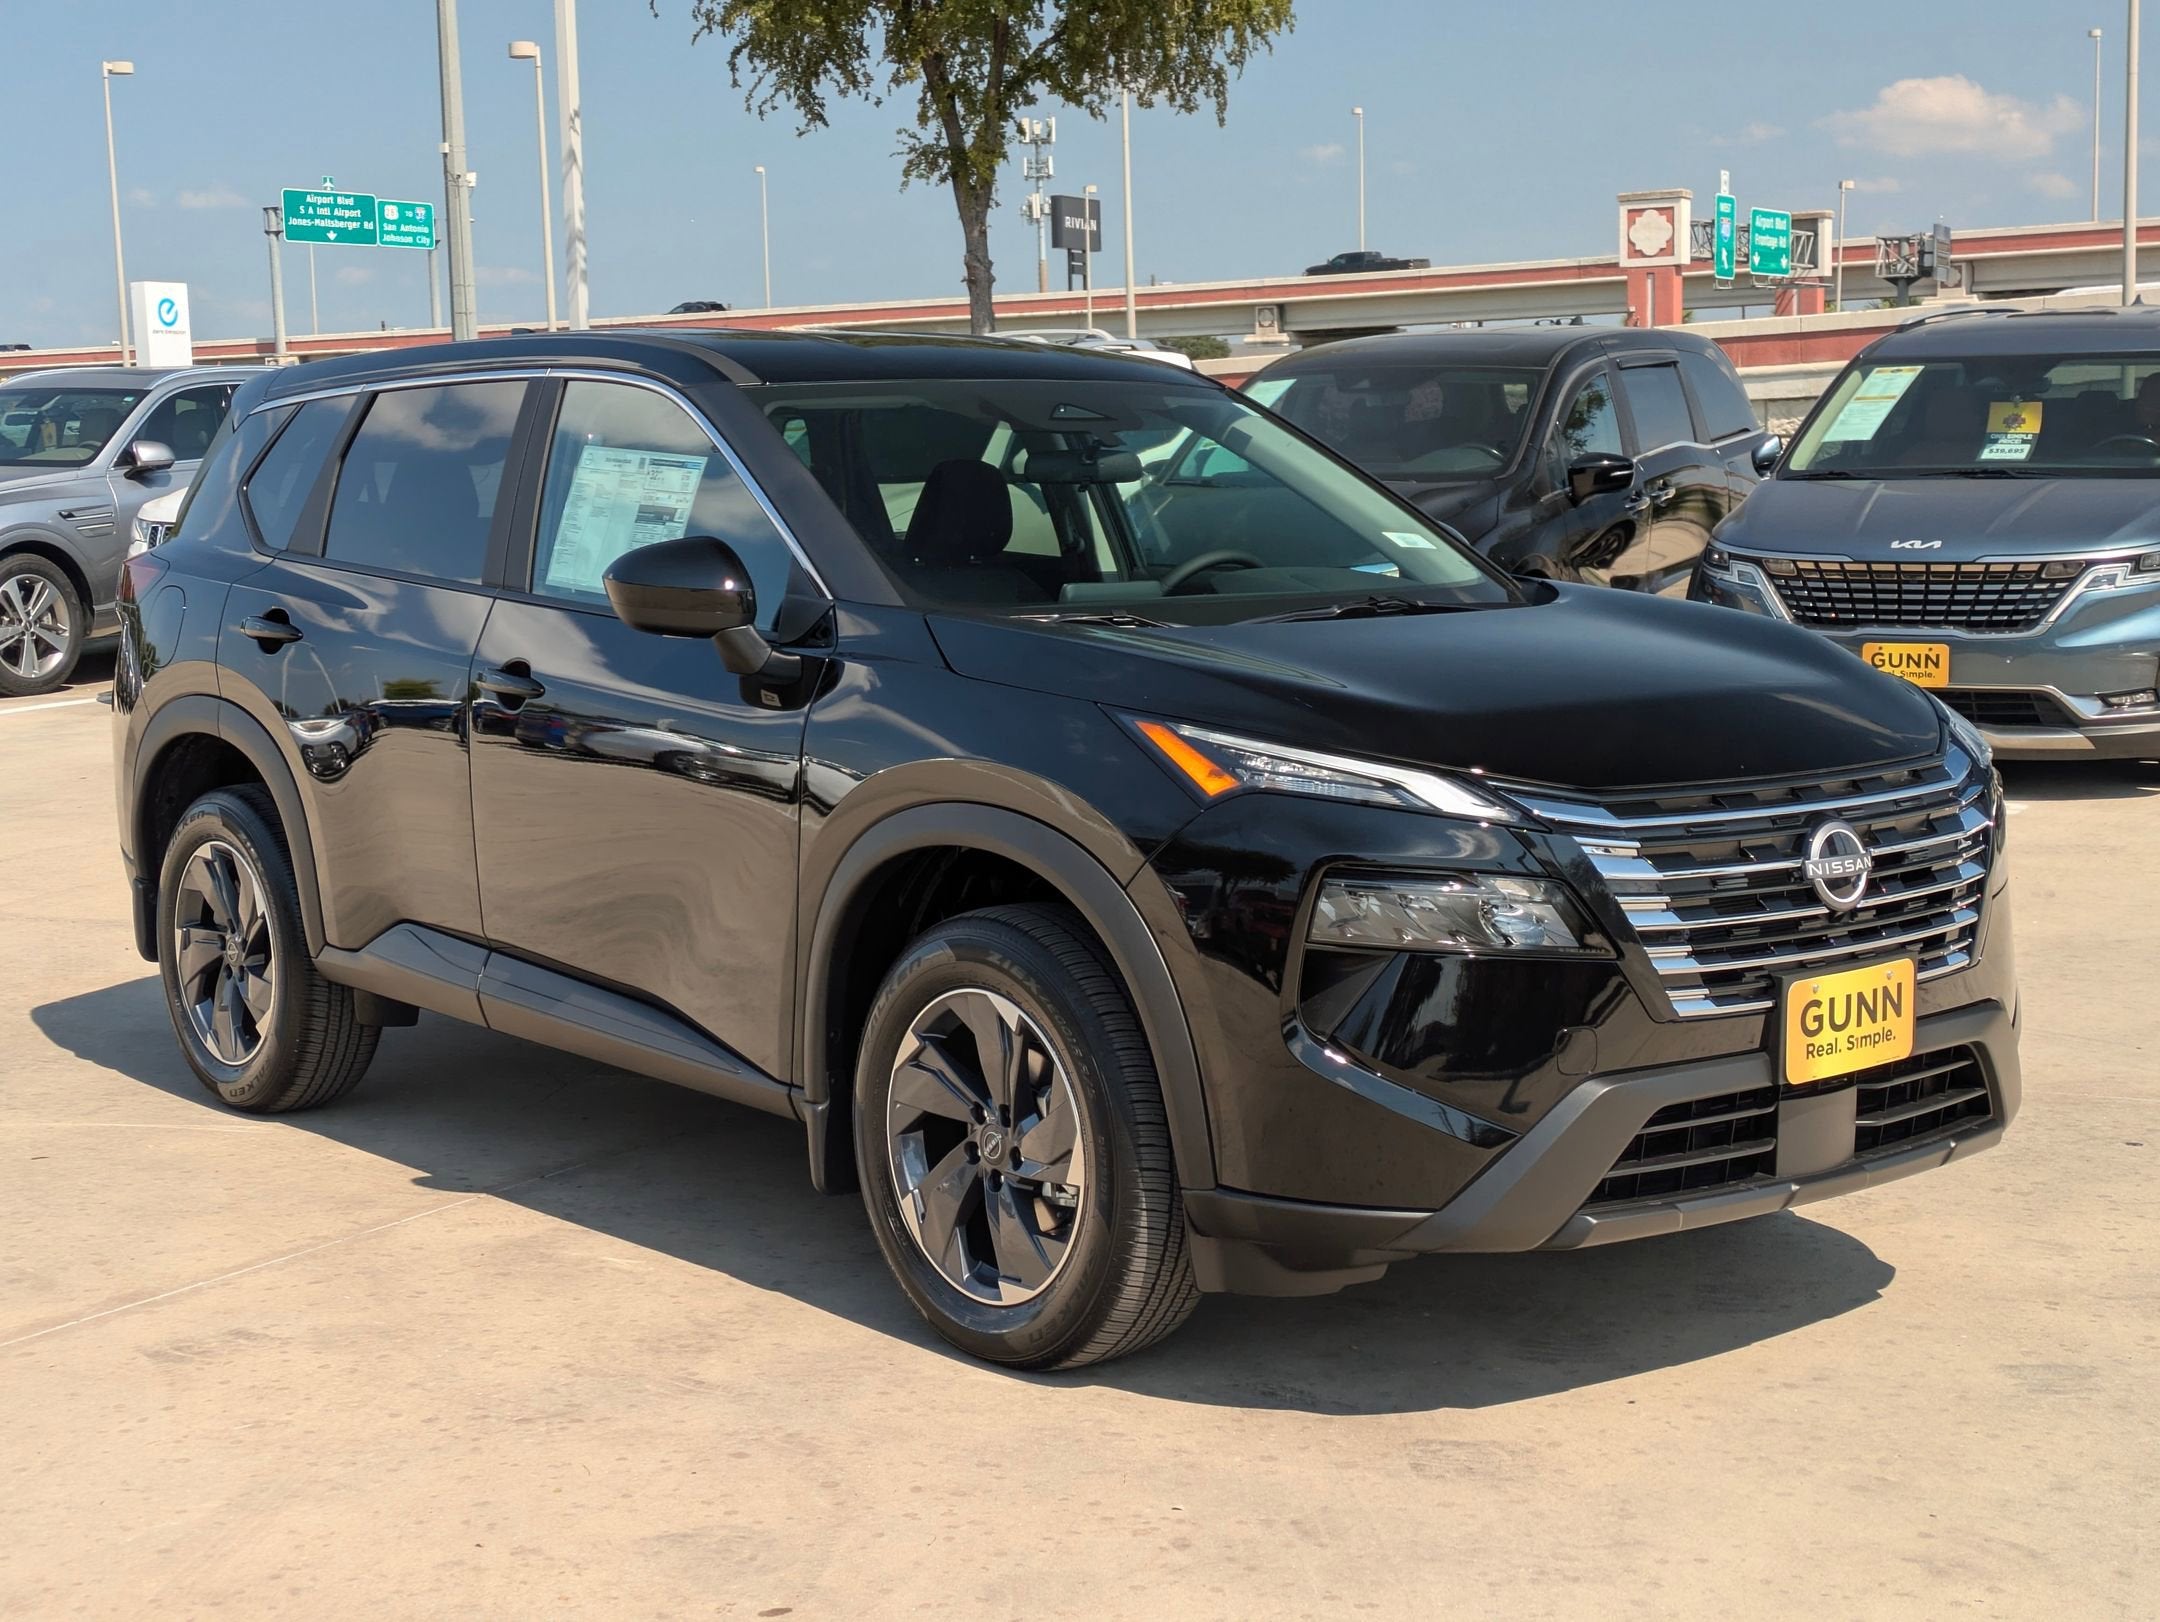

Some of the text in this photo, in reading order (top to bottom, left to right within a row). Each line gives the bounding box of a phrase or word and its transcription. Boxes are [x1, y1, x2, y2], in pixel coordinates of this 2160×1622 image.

[305, 194, 355, 206] Airport Blvd
[299, 205, 306, 214] S
[307, 206, 315, 215] A
[333, 207, 362, 219] Airport
[363, 221, 374, 230] Rd
[382, 222, 430, 233] San Antonio
[1871, 652, 1941, 669] GUNN
[1808, 855, 1872, 876] NISSAN
[1800, 982, 1903, 1038] GUNN
[1806, 1037, 1842, 1060] Real.
